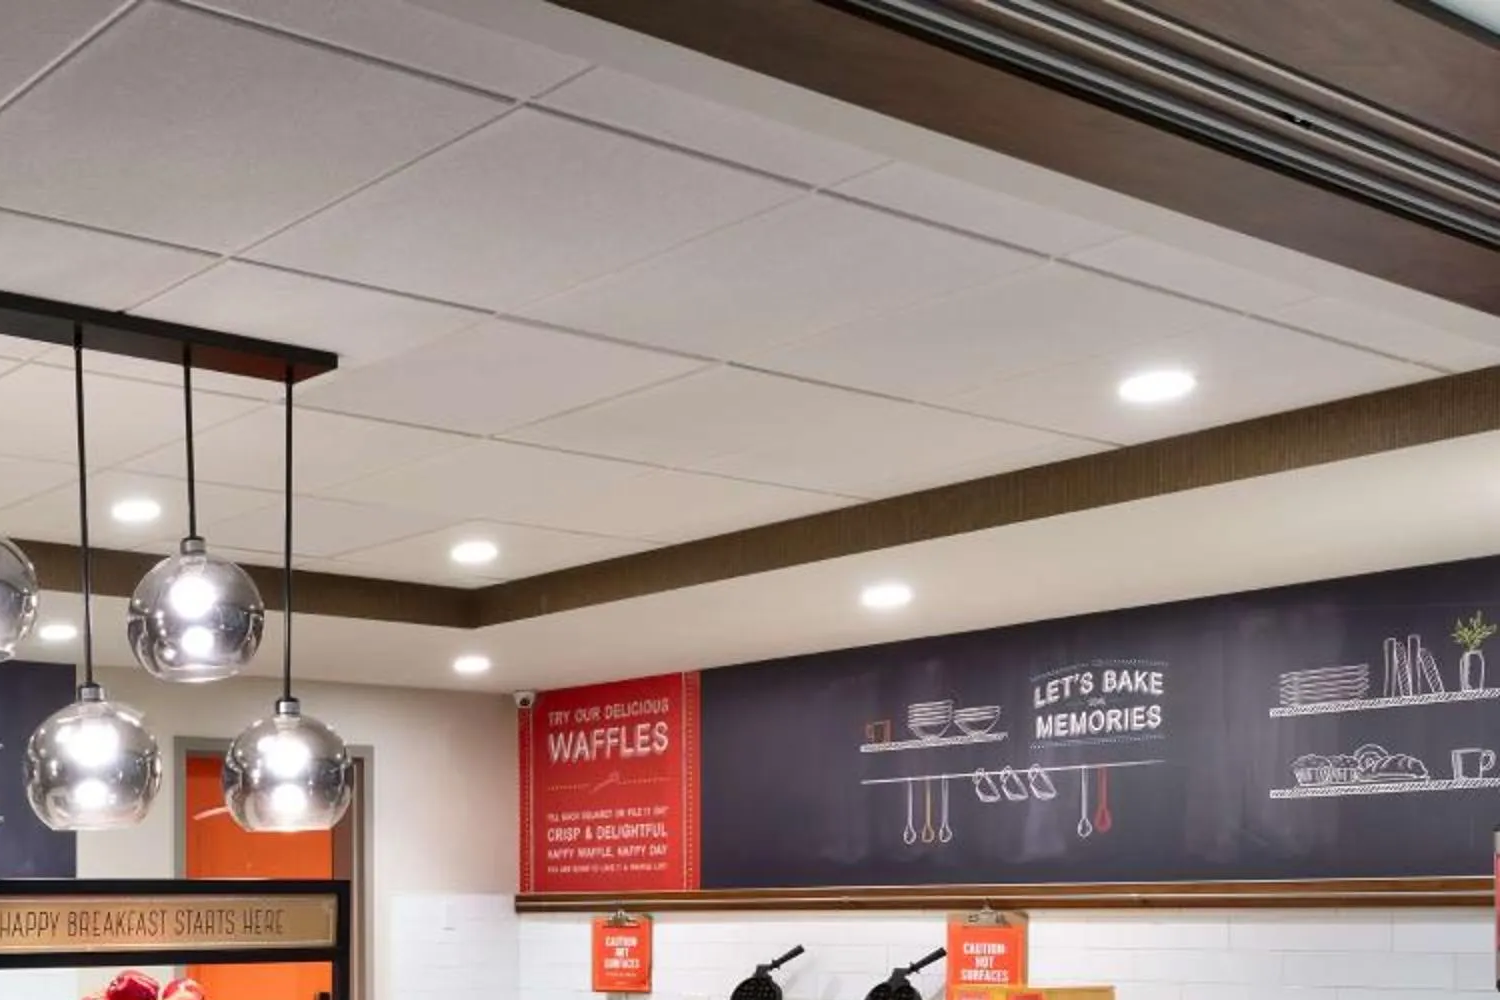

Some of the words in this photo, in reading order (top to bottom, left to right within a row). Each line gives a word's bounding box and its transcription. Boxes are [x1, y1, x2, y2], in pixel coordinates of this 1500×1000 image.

[1033, 671, 1094, 709] LET'S
[1102, 668, 1165, 696] BAKE
[548, 710, 571, 726] TRY
[574, 706, 600, 723] OUR
[604, 697, 669, 720] DELICIOUS
[1035, 704, 1163, 740] MEMORIES
[548, 720, 669, 763] WAFFLES
[547, 827, 581, 842] CRISP
[585, 825, 593, 840] &
[596, 822, 668, 841] DELIGHTFUL
[0, 911, 60, 938] HAPPY
[66, 909, 168, 937] BREAKFAST
[174, 908, 236, 936] STARTS
[243, 908, 285, 935] HERE
[961, 969, 1009, 982] SURFACES
[975, 955, 994, 969] HOT
